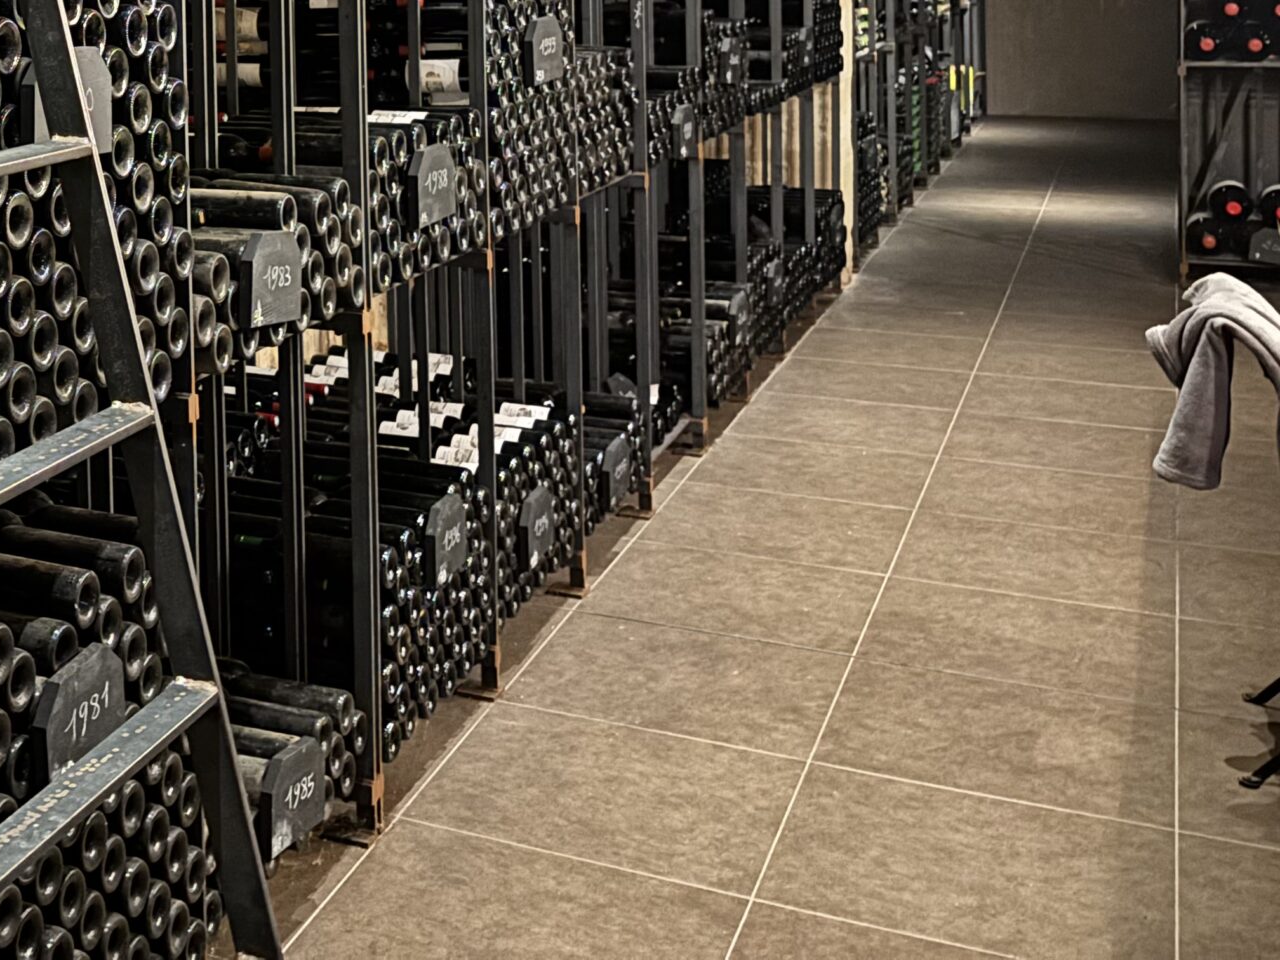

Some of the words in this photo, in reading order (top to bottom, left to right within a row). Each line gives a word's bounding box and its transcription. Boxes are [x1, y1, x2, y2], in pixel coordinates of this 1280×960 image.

[262, 264, 292, 291] 1983
[64, 680, 110, 742] 1981
[284, 771, 316, 810] 1985
